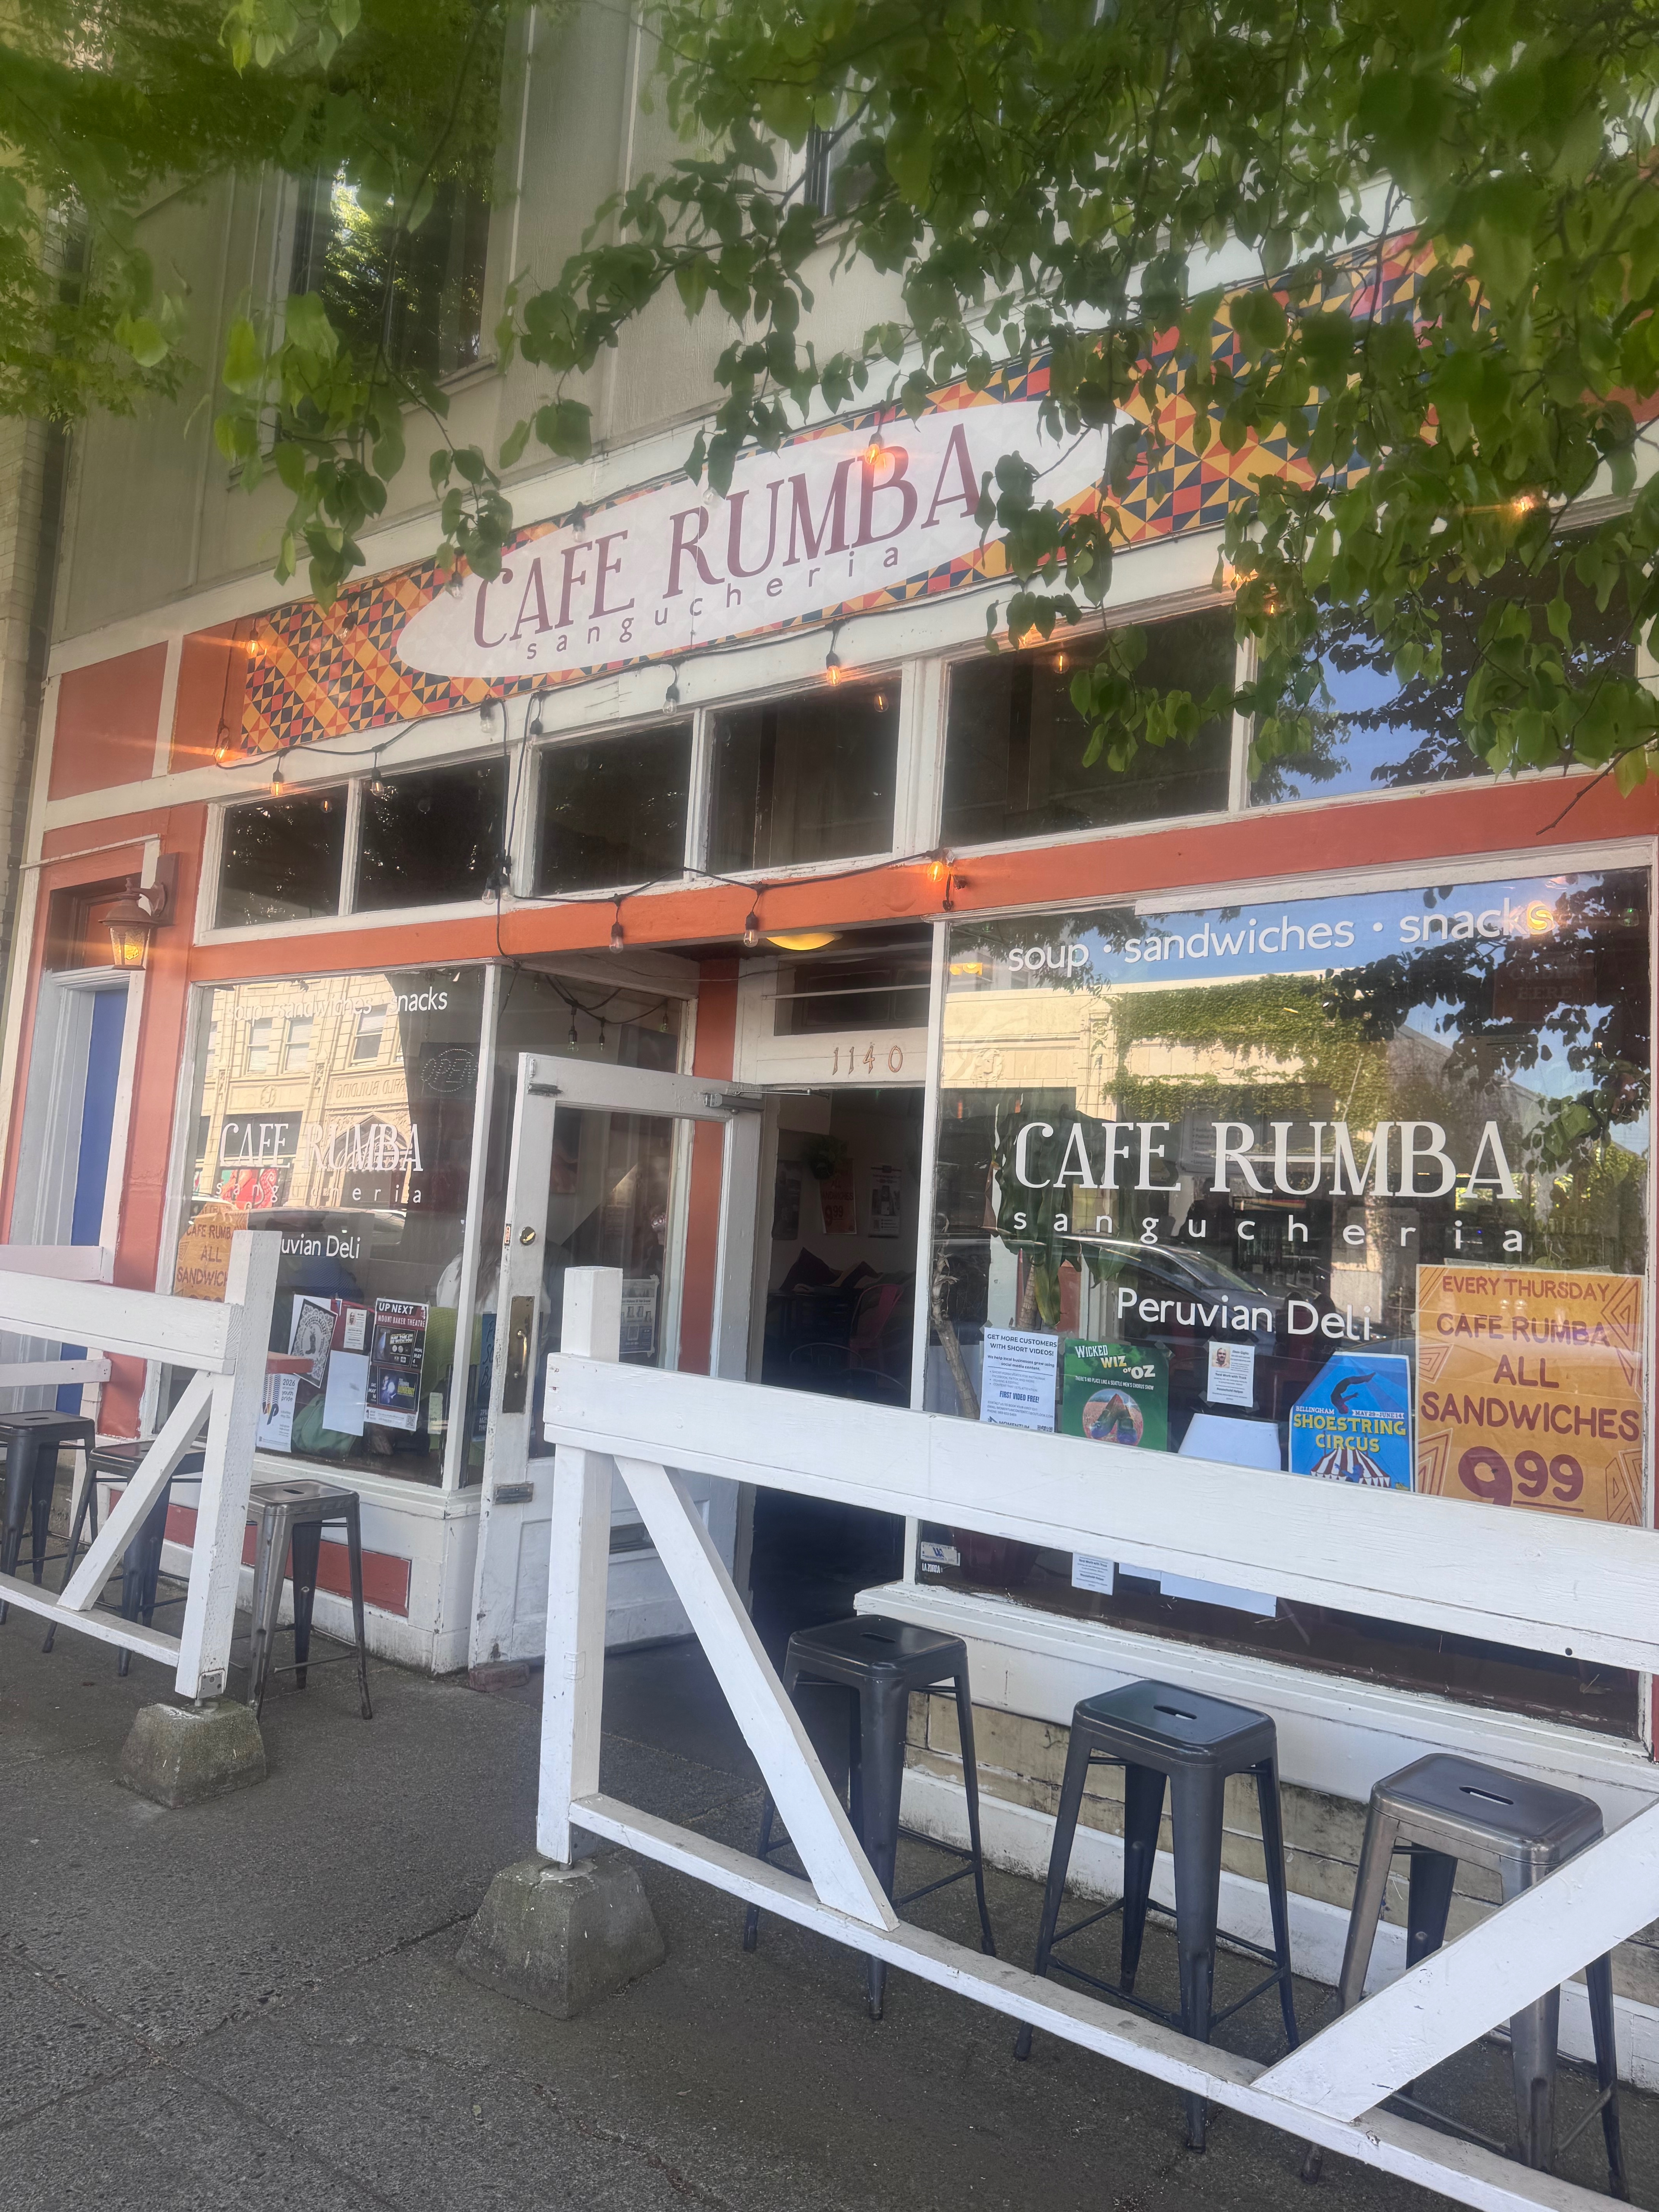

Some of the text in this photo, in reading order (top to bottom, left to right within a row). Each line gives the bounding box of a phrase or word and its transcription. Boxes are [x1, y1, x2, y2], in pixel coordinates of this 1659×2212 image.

[474, 424, 984, 649] CAFE RUMBA
[526, 545, 899, 661] sangucheria
[1008, 898, 1555, 978] soup sandwiches snacks
[276, 992, 373, 1018] sandwiches
[388, 986, 448, 1014] snacks
[832, 1045, 903, 1075] 1140
[220, 1122, 423, 1172] CAFE RUMBA
[1015, 1121, 1182, 1192] CAFE
[1211, 1120, 1524, 1200] RUMBA
[186, 1224, 206, 1238] CAFE
[1014, 1210, 1523, 1253] sangucheria
[201, 1245, 222, 1262] ALL
[326, 1235, 361, 1259] Deli
[1443, 1275, 1611, 1302] EVERY THURSDAY
[378, 1302, 414, 1315] UP NEXT
[1118, 1287, 1370, 1341] Peruvian Deli
[378, 1314, 426, 1328] MOUNT BAKER THEATRE
[1436, 1313, 1611, 1347] CAFE RUMBA
[1019, 1338, 1057, 1347] CUSTOMERS
[1029, 1348, 1054, 1356] VIDEOS!
[1074, 1345, 1108, 1358] WICKED
[1100, 1355, 1127, 1369] WIZ
[1131, 1364, 1156, 1379] OZ
[1494, 1354, 1560, 1389] ALL
[1013, 1392, 1026, 1401] VIDEO
[1027, 1395, 1039, 1403] FREE!
[1295, 1406, 1334, 1414] BELLINGHAM
[1421, 1391, 1640, 1442] SANDWICHES
[1293, 1414, 1406, 1436] SHOESTRING
[1316, 1434, 1380, 1453] CIRCUS
